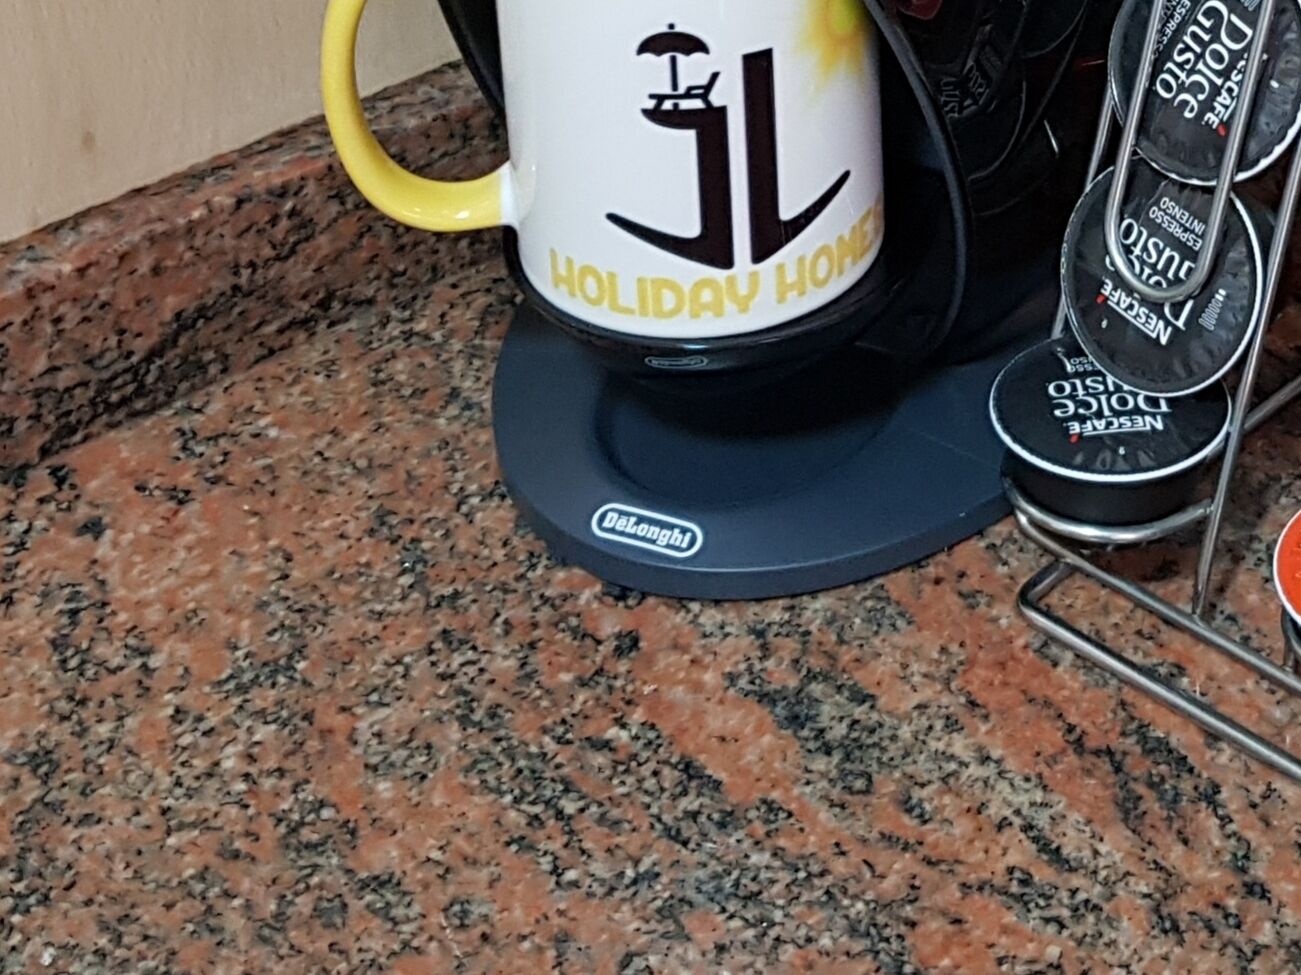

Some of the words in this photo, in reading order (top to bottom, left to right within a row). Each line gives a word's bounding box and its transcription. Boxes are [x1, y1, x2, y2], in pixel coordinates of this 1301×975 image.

[1156, 0, 1229, 99] Gusto
[1174, 14, 1253, 119] Dolce
[1149, 206, 1203, 251] ESPRESSO
[1160, 197, 1205, 235] INTENSO
[550, 248, 761, 319] HOLIDAY
